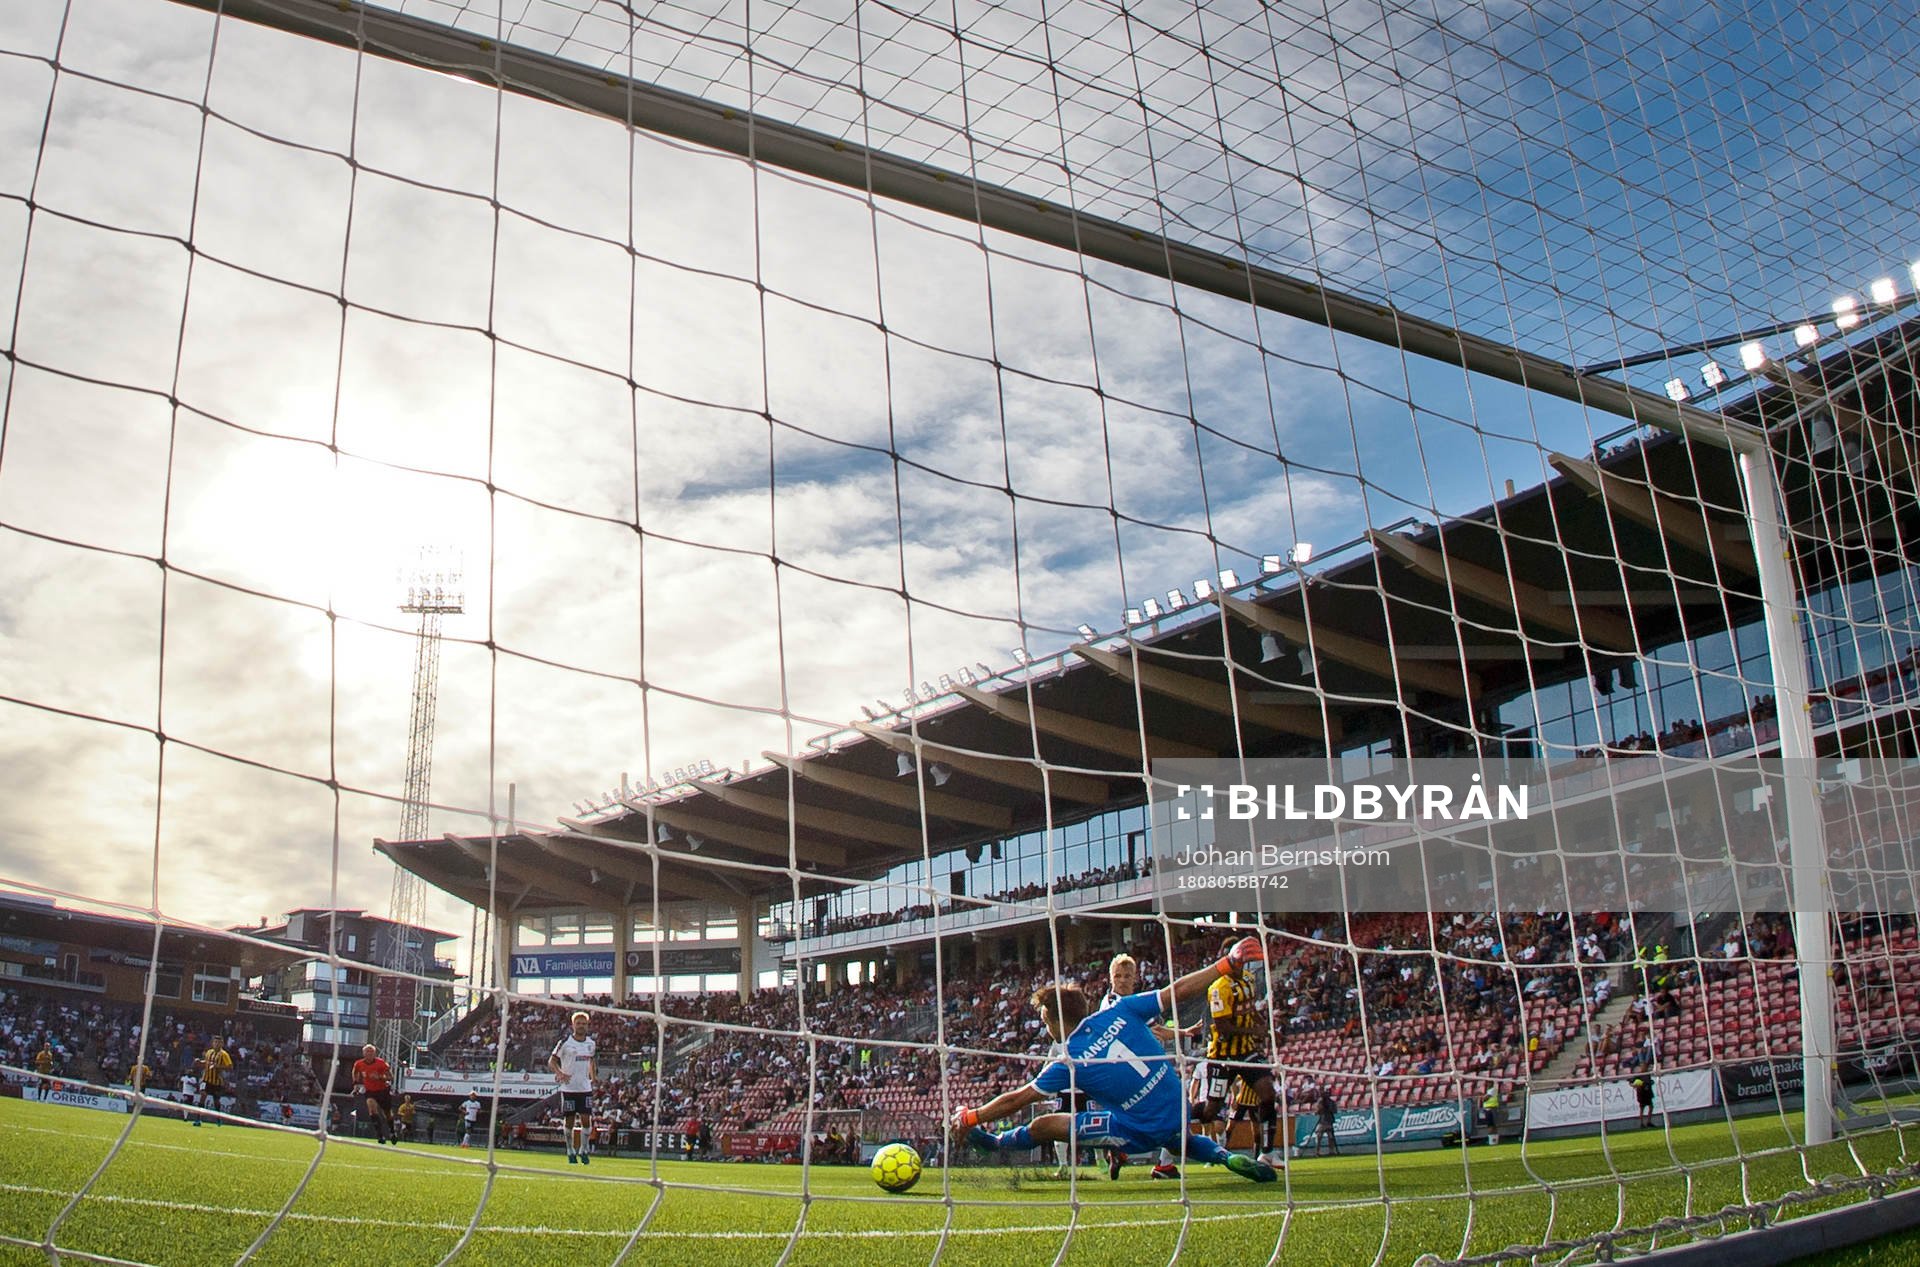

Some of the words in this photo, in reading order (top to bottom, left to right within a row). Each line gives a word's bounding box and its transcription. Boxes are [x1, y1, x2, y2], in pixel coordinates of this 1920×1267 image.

[516, 957, 542, 974] NA
[545, 959, 613, 974] Familjeläktare
[1106, 1038, 1151, 1078] 1
[1750, 1064, 1770, 1078] We
